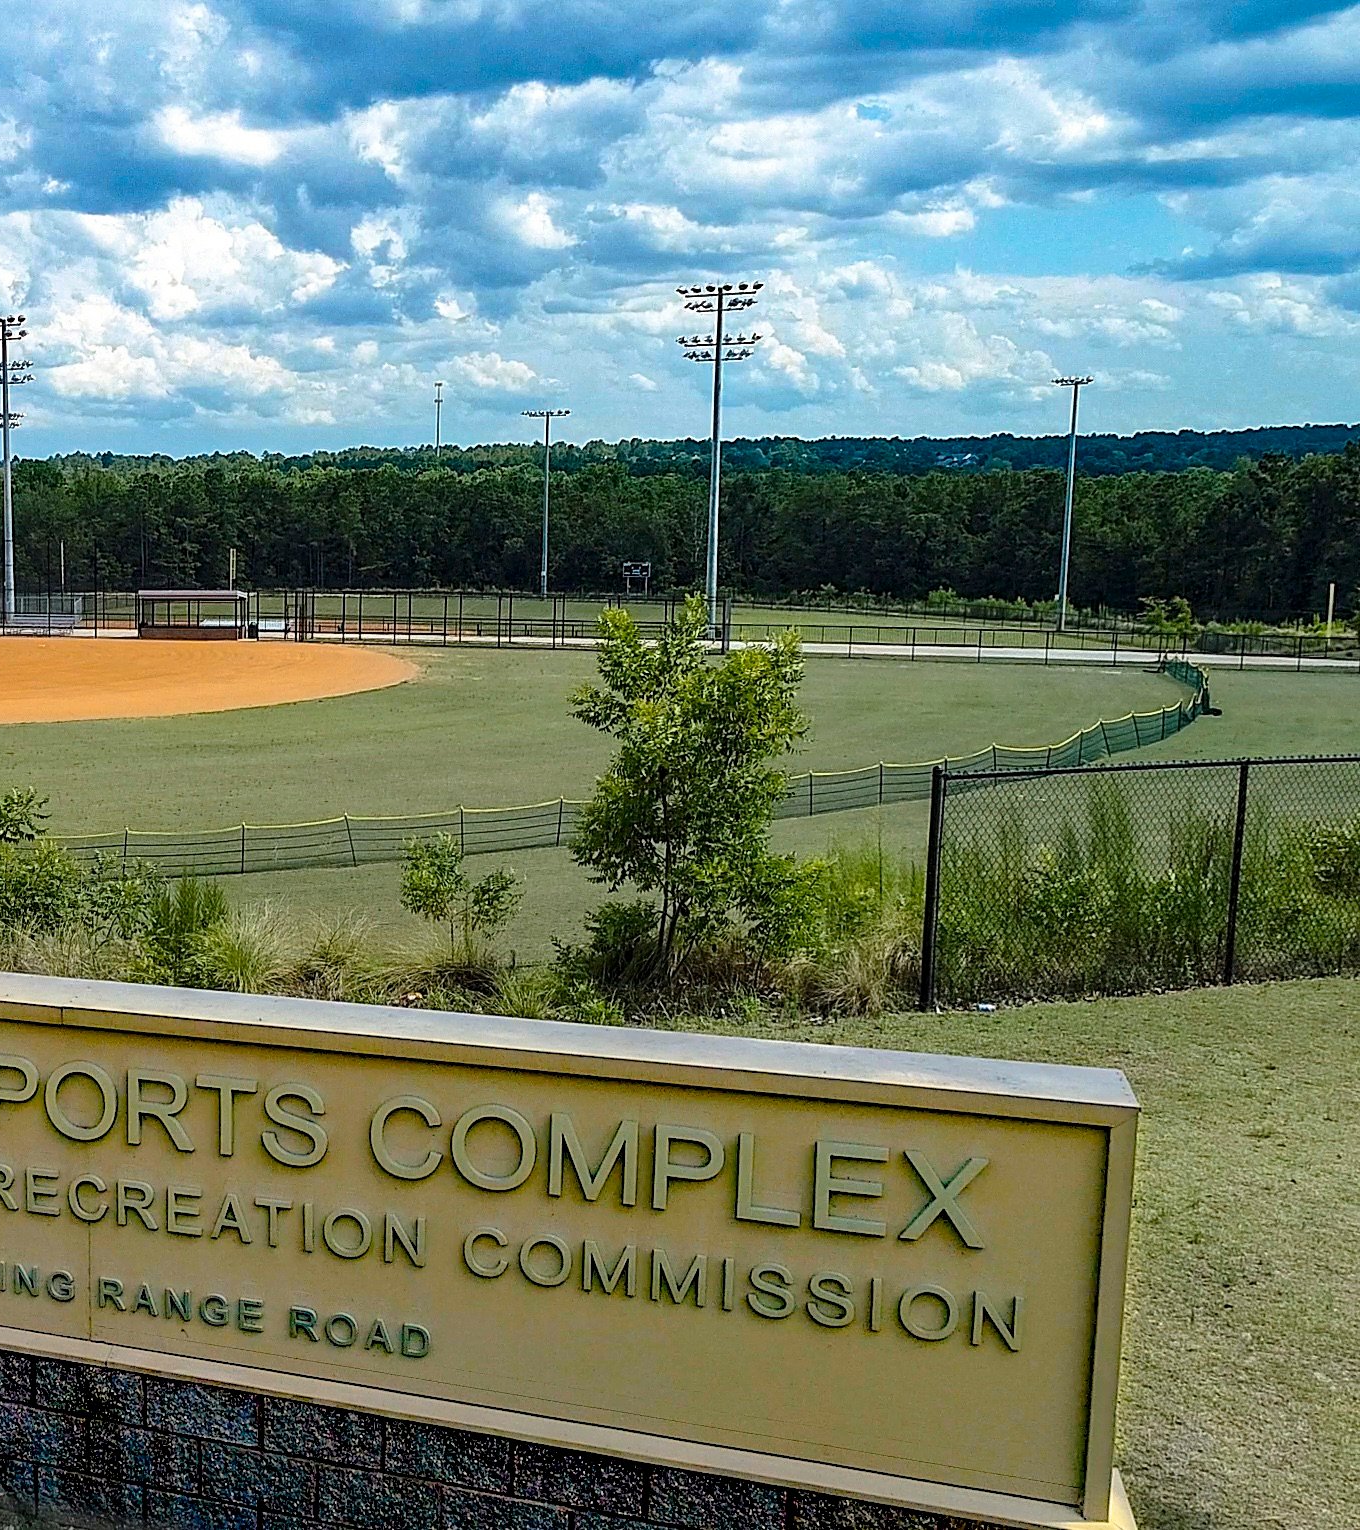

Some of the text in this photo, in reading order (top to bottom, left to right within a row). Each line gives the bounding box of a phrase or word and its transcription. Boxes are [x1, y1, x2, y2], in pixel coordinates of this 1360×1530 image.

[370, 1095, 988, 1249] COMPLEX
[98, 1276, 265, 1333] RANGE
[289, 1305, 432, 1359] ROAD
[462, 1226, 1024, 1352] COMMISSION
